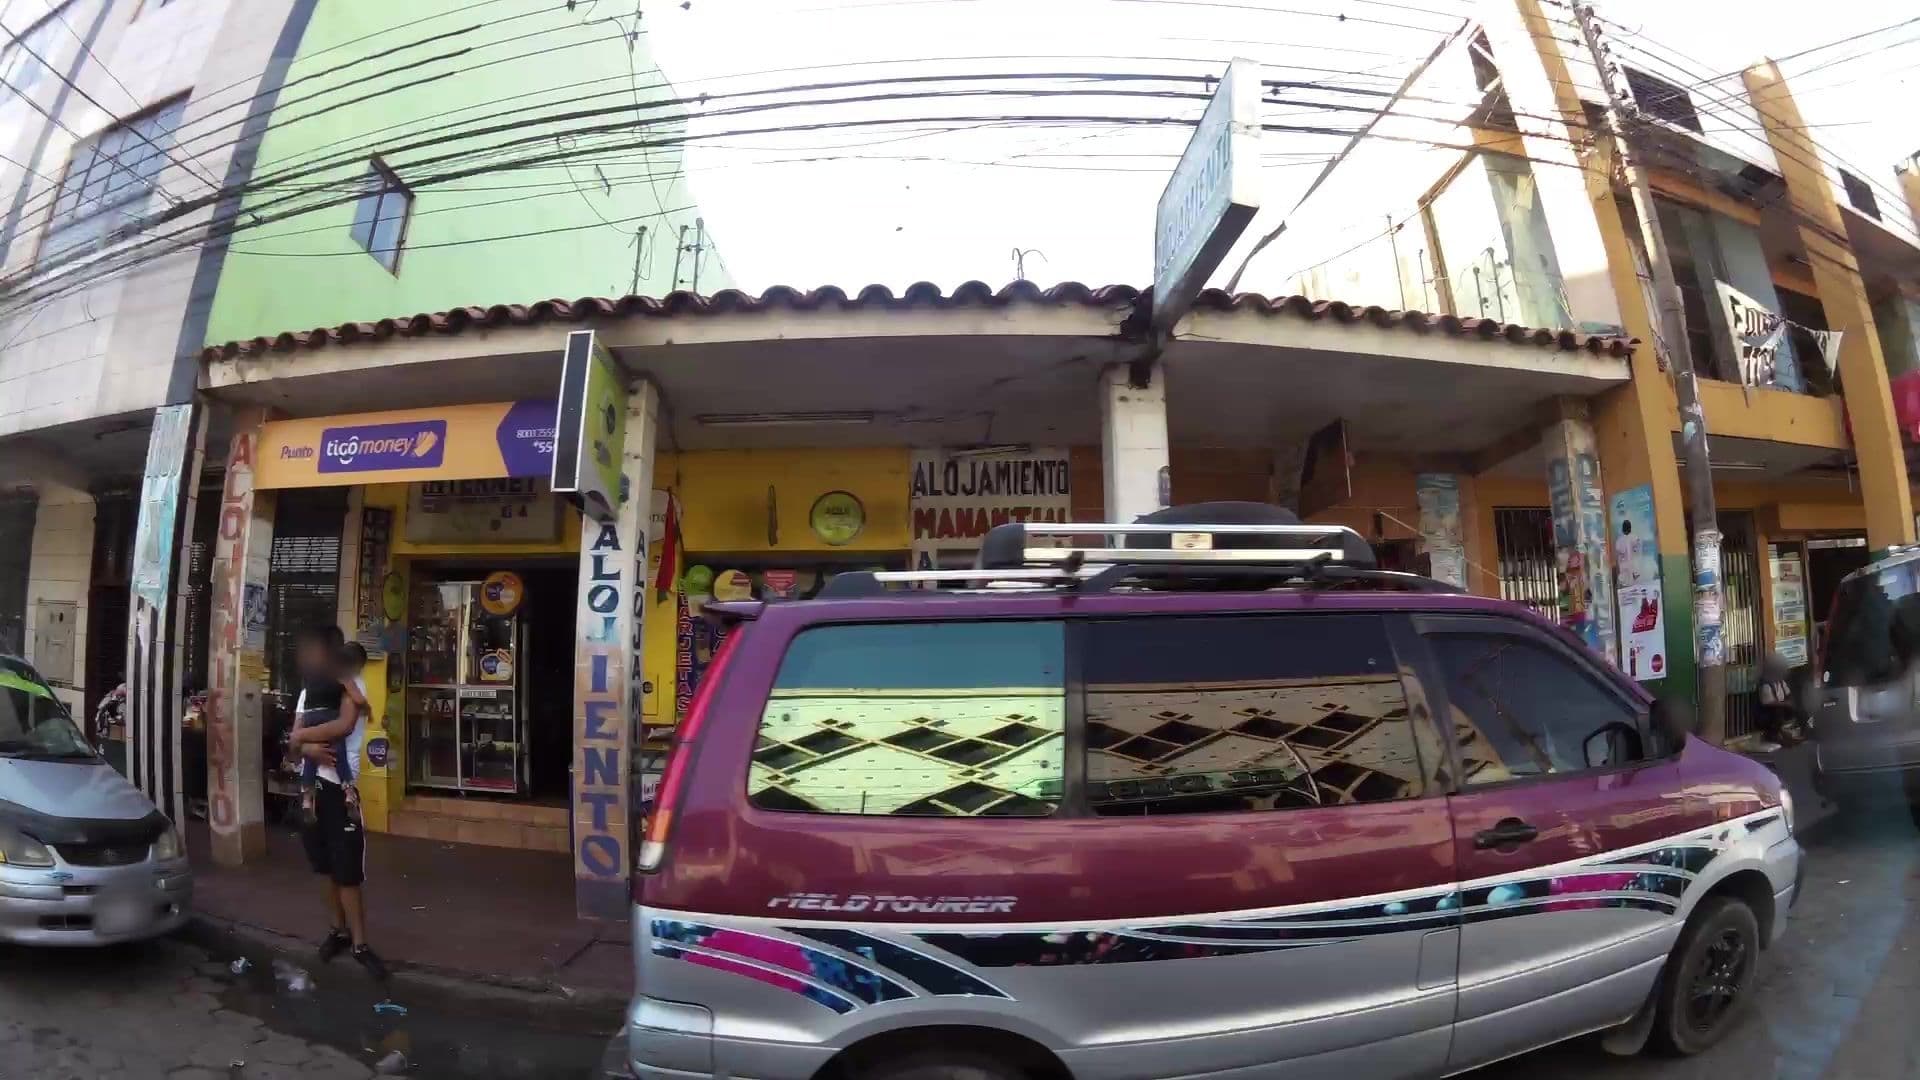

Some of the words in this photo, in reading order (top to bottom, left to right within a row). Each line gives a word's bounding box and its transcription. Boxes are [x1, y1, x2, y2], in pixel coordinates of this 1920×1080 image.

[280, 446, 313, 460] Punto
[912, 459, 1070, 496] ALOJAMIENTO
[207, 434, 253, 828] ALOJMIENTO
